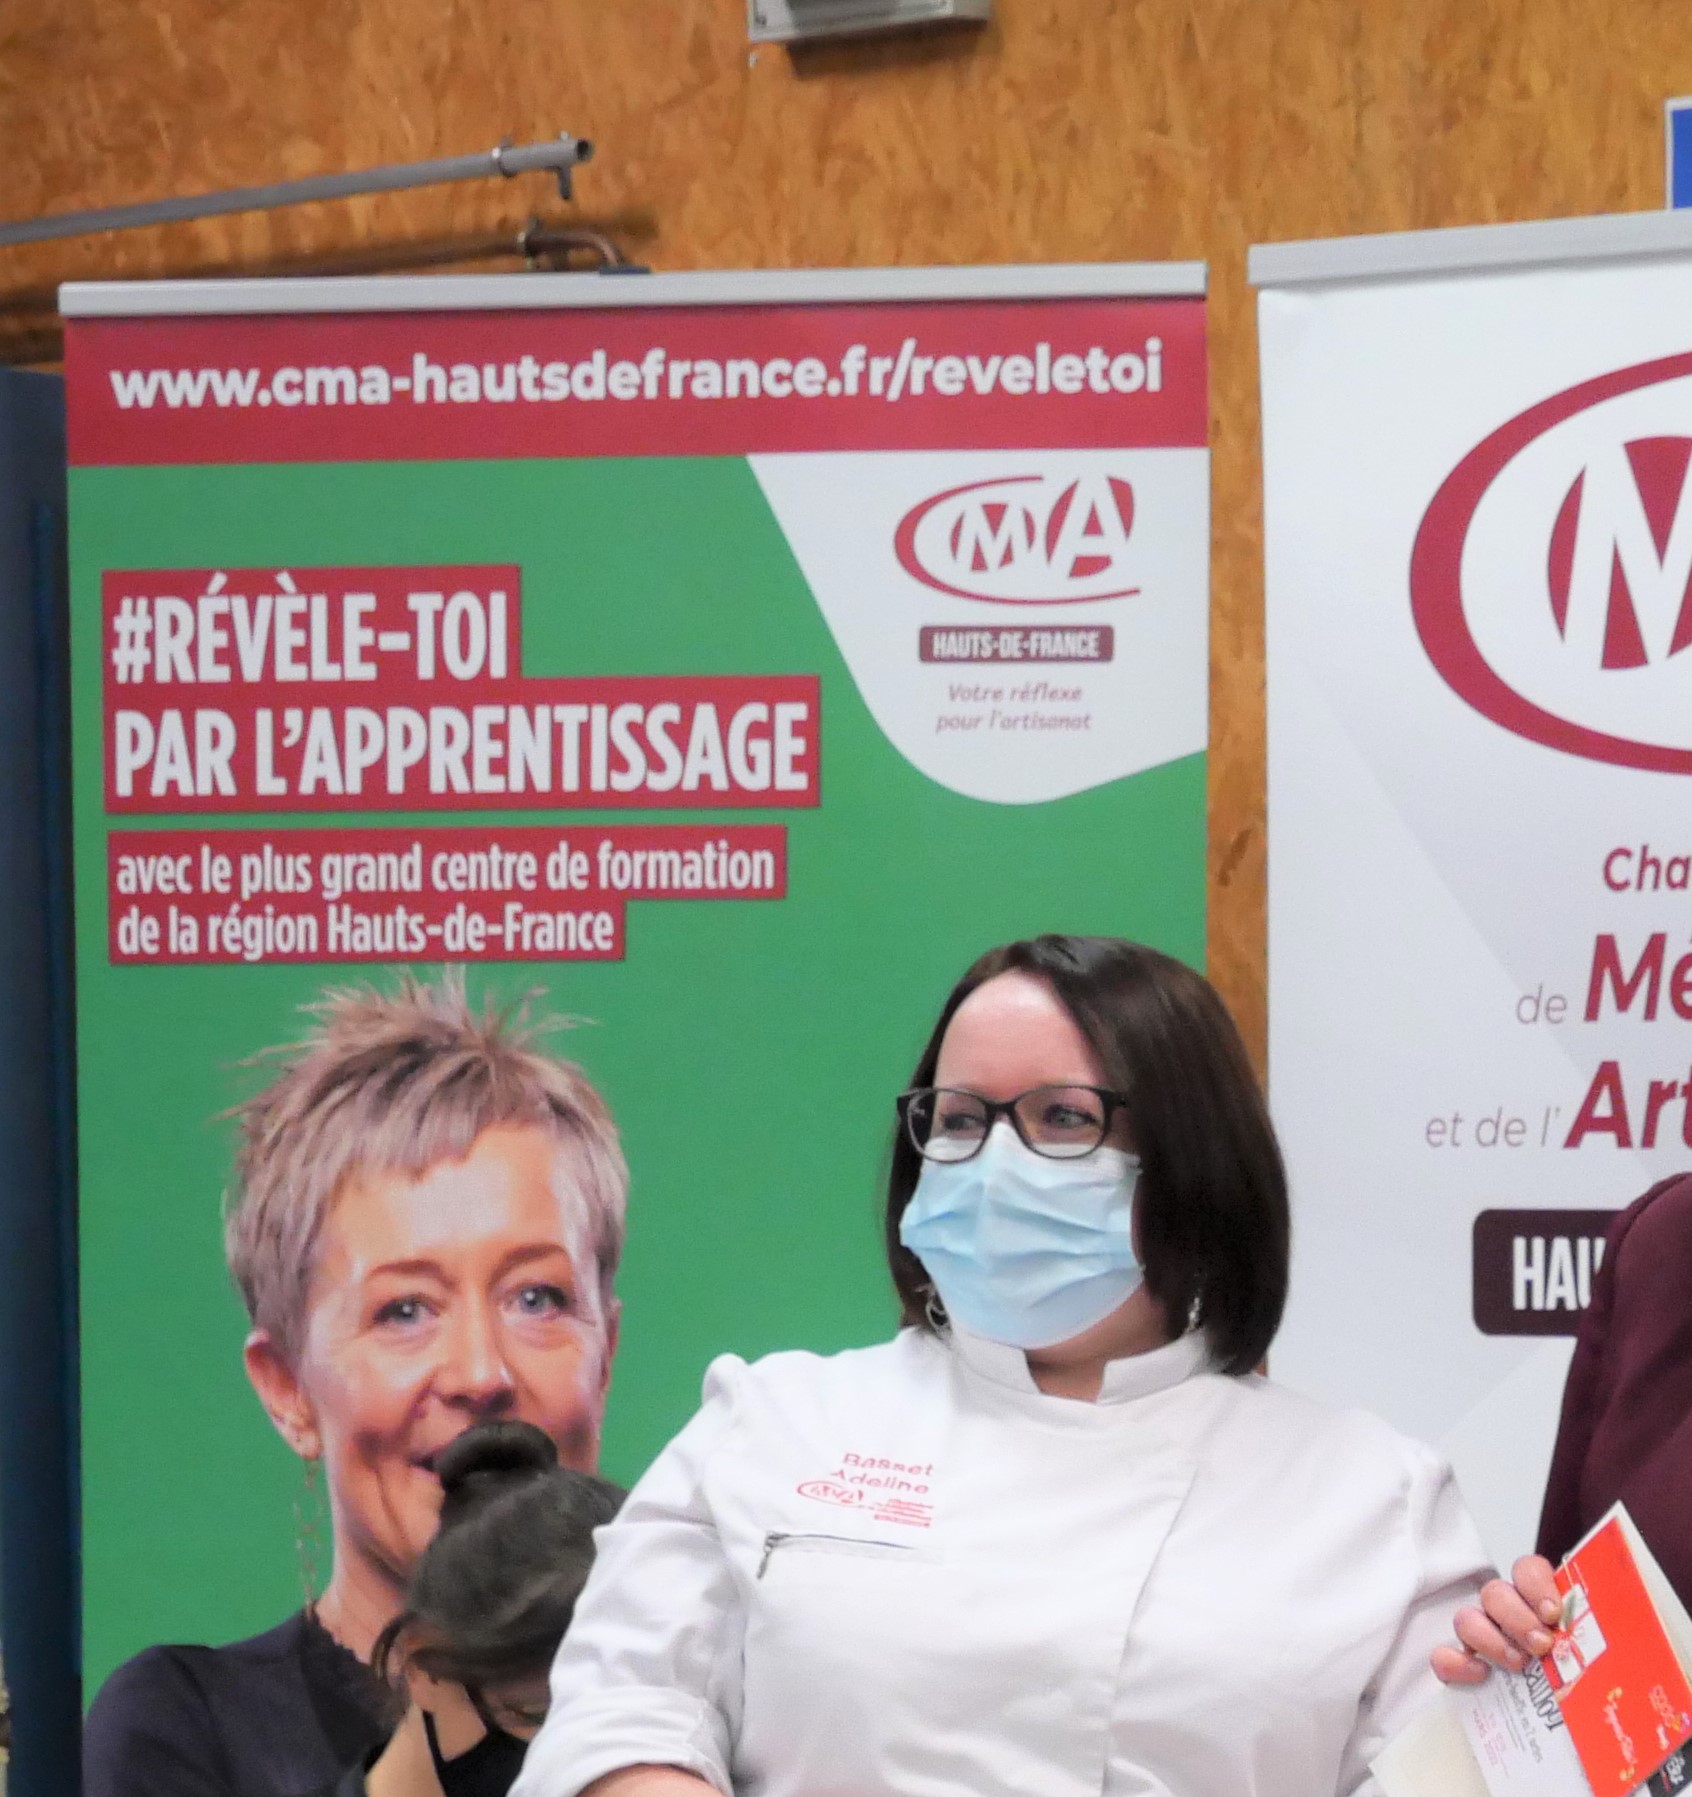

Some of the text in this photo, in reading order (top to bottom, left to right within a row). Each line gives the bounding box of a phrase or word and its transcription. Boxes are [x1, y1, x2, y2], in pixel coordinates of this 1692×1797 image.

[110, 337, 1163, 408] www.cma-hautsdefrance.fr/reveletoi
[112, 572, 508, 684] #RÉVÈLE-TOI
[932, 631, 1101, 658] HAUTS-DE-FRANCE
[949, 683, 1003, 702] Votre
[113, 702, 810, 798] PAR L'APPRENTISSAGE
[935, 714, 982, 735] pour
[116, 839, 776, 901] avec le plus grand centre de formation
[118, 901, 615, 962] de la région Hauts-de-France
[1516, 983, 1568, 1025] de
[1425, 1111, 1463, 1148] et
[1475, 1107, 1527, 1148] de
